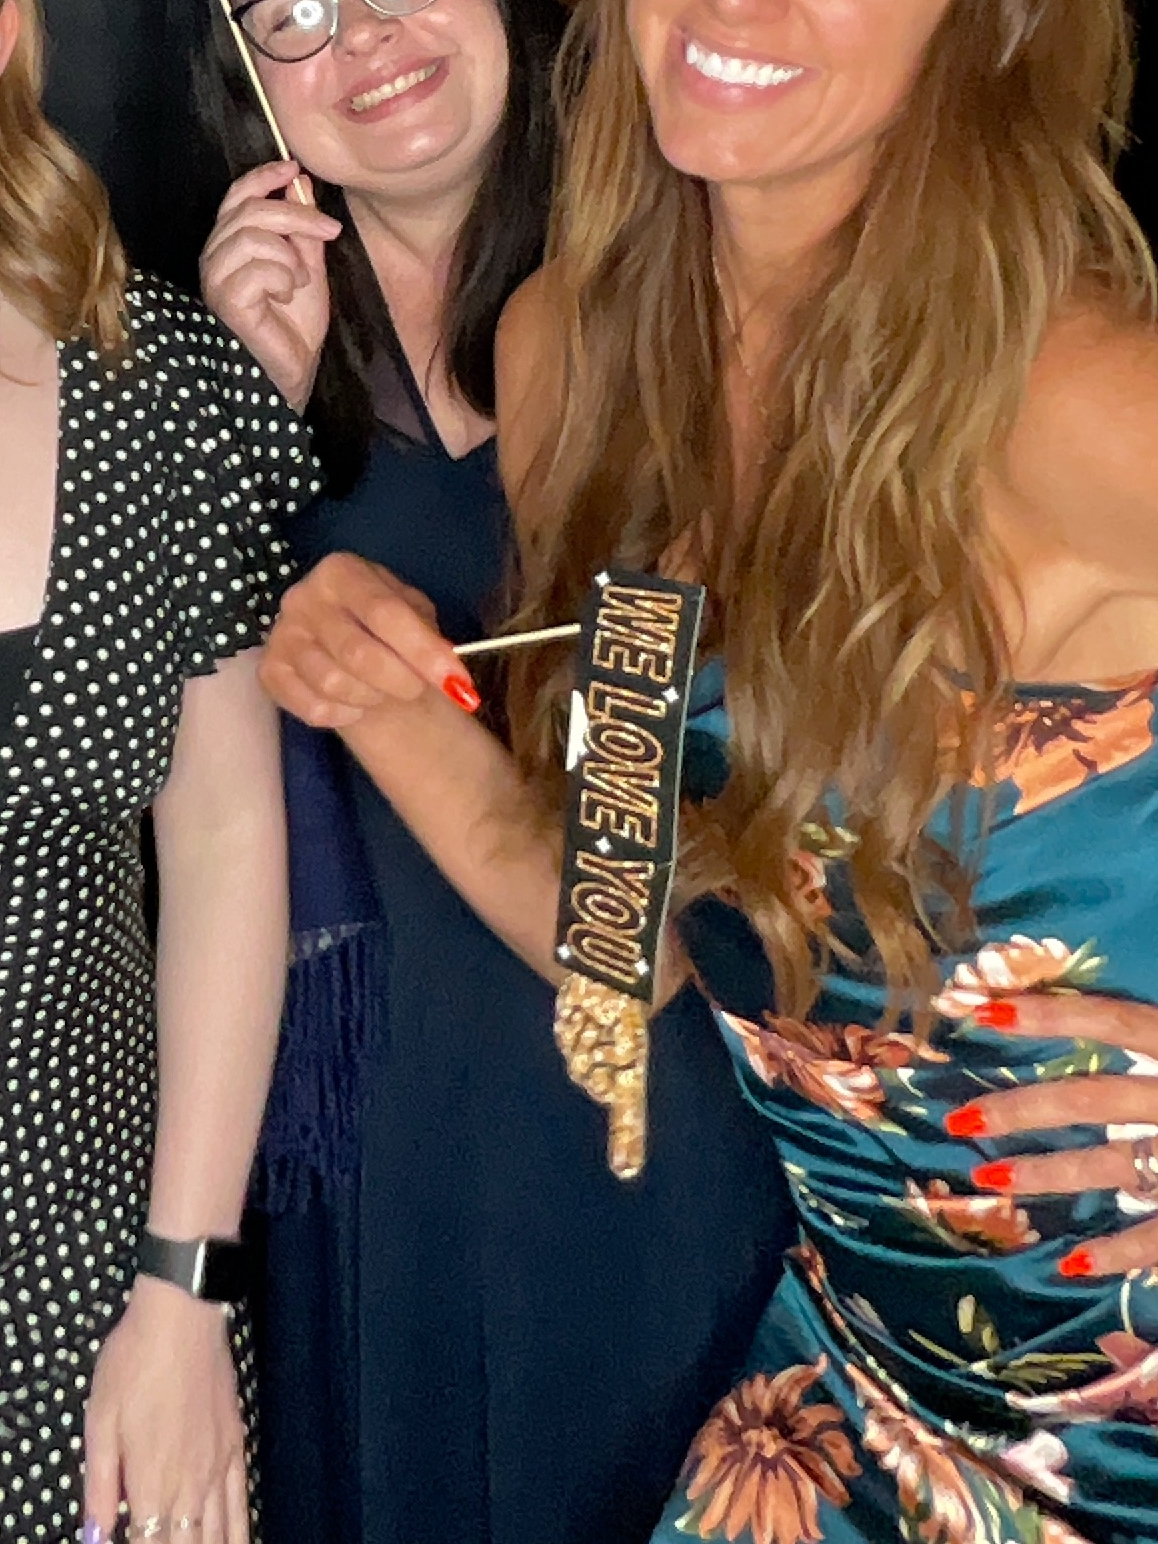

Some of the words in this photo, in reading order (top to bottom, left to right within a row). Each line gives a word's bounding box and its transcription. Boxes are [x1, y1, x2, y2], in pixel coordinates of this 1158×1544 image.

[592, 585, 683, 684] WE
[581, 681, 666, 848] LOVE
[567, 850, 655, 985] YOU
